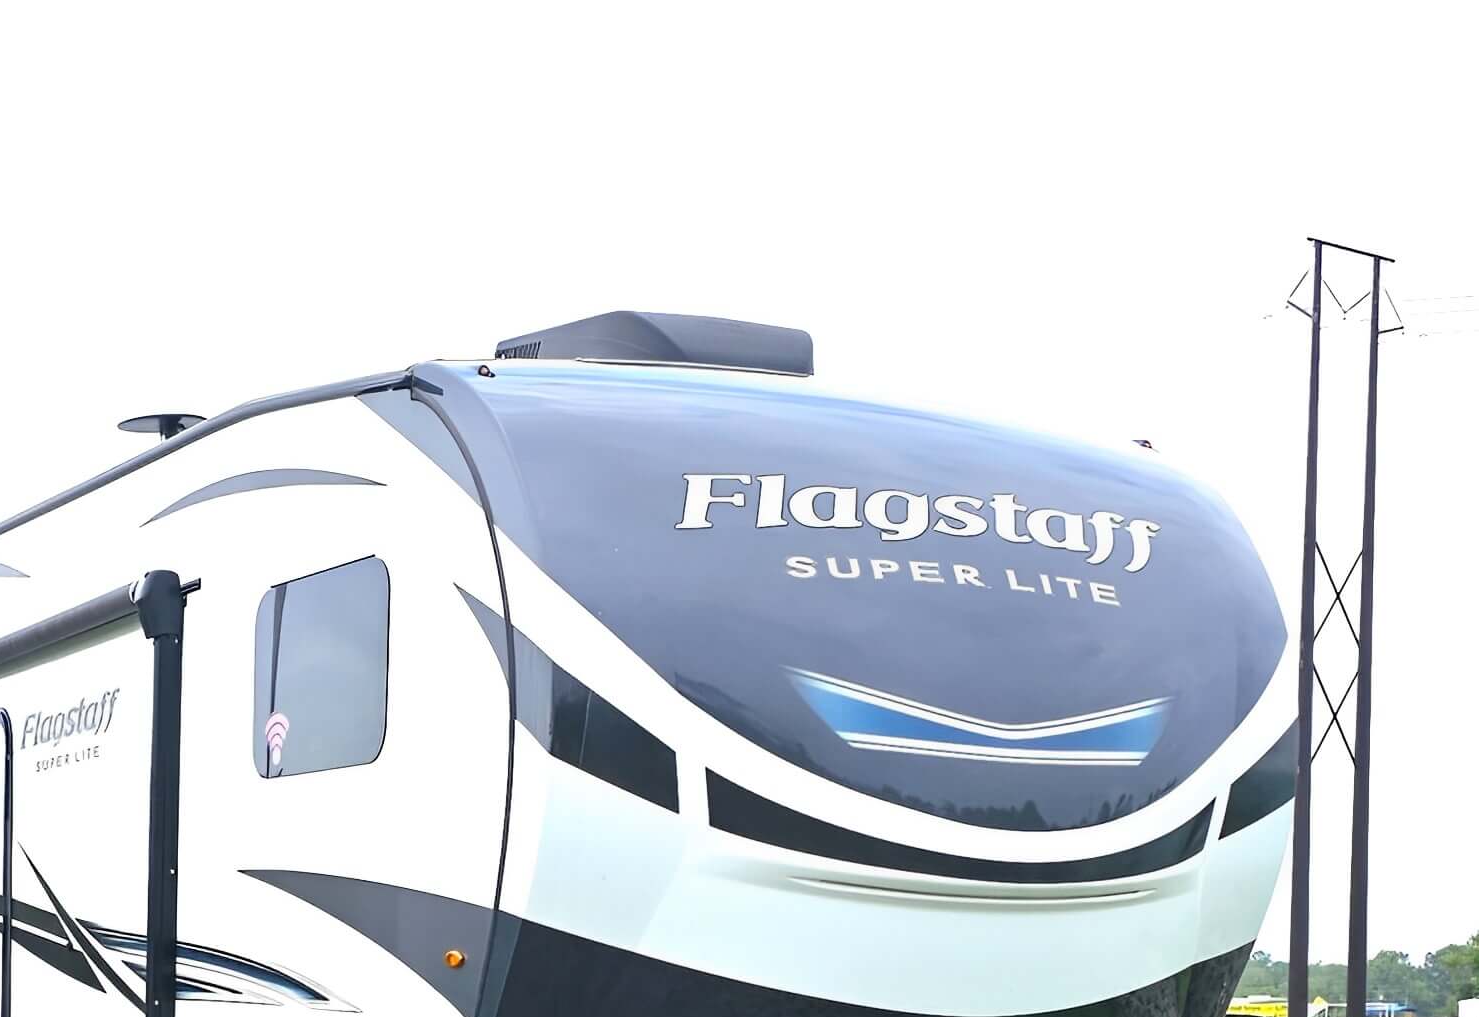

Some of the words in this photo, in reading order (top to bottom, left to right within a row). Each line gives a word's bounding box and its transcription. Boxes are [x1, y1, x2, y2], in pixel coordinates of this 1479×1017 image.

[674, 472, 1161, 573] Flagstaff
[785, 555, 990, 588] SUPER
[1004, 568, 1122, 607] LITE
[20, 688, 120, 750] Flagstaff
[35, 753, 70, 773] SUPER
[74, 745, 100, 763] LITE
